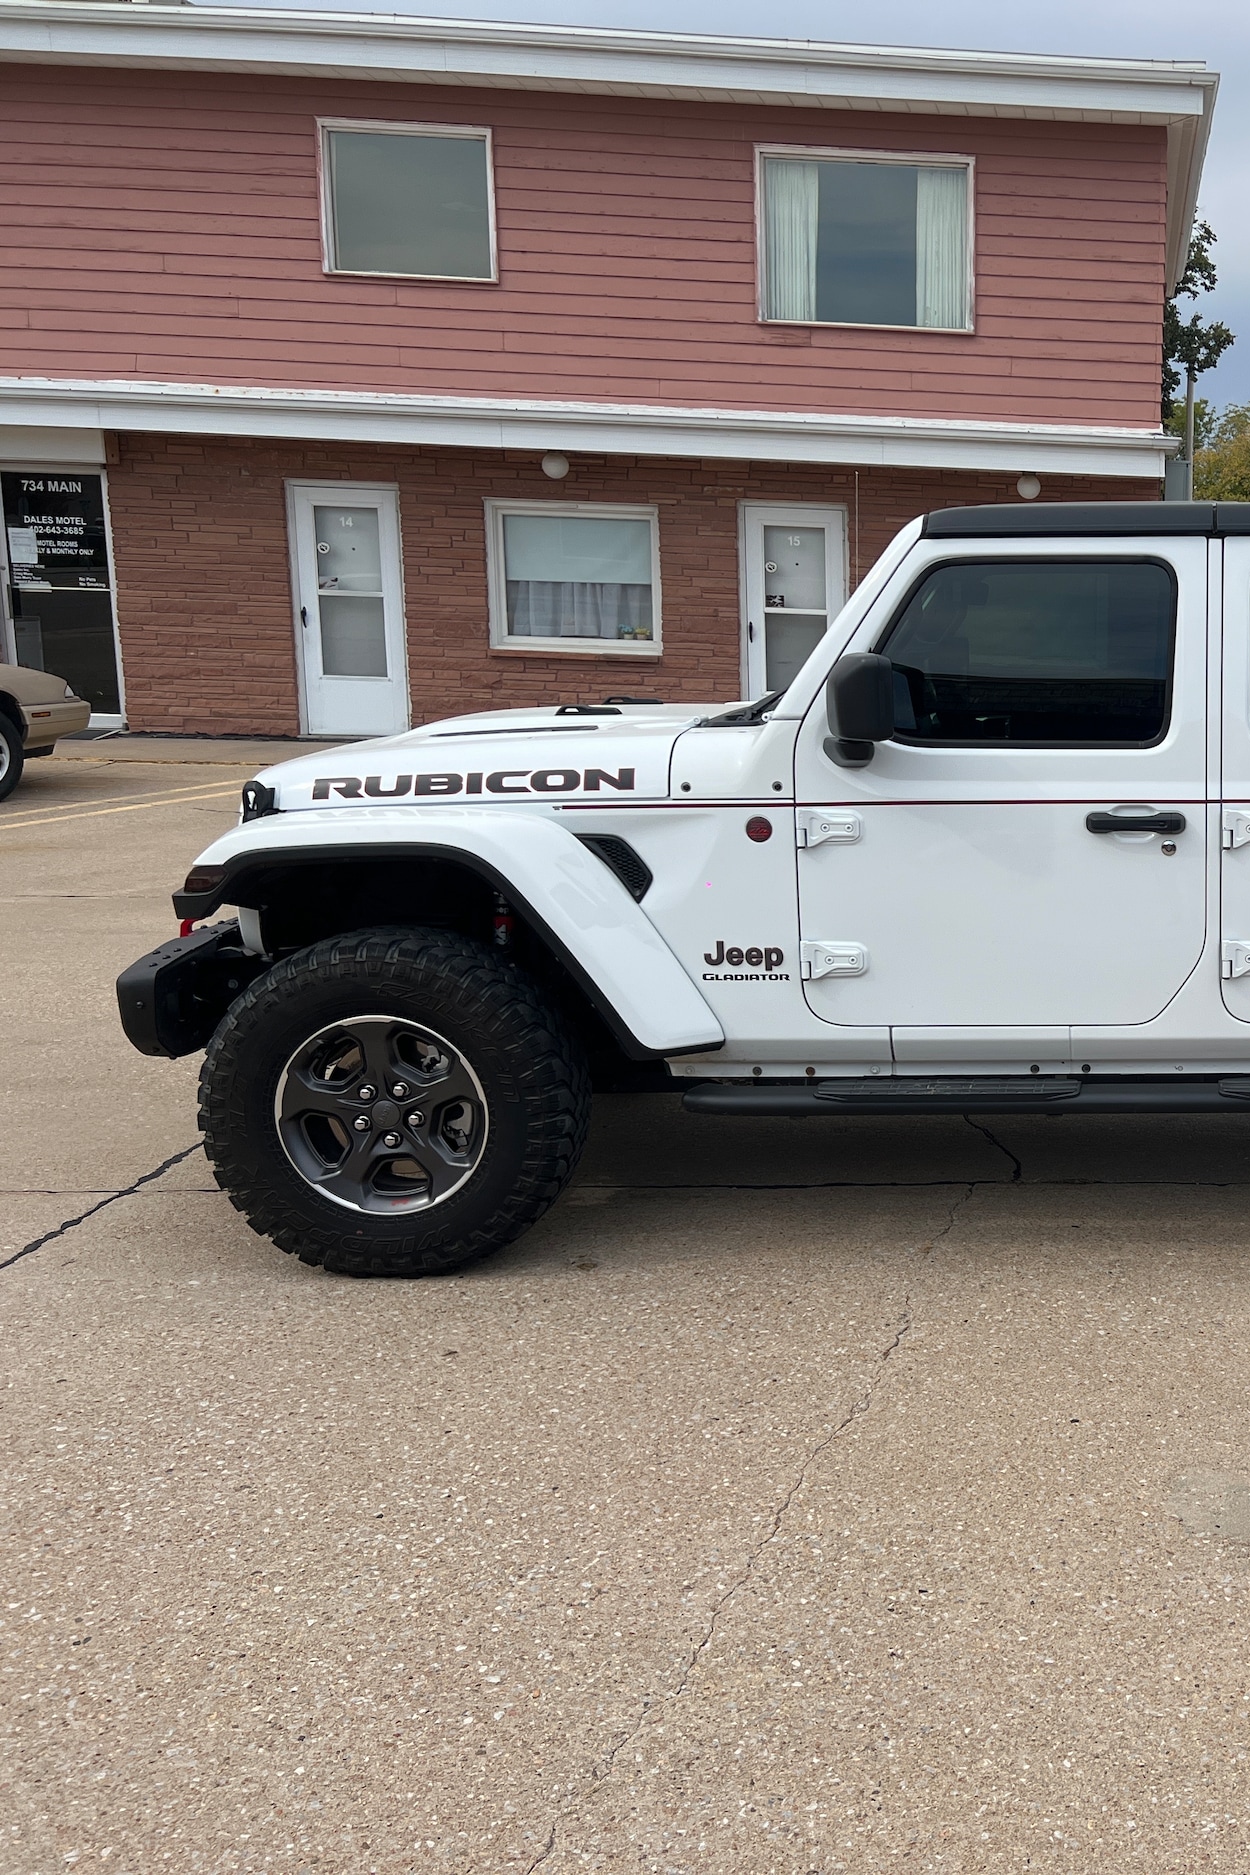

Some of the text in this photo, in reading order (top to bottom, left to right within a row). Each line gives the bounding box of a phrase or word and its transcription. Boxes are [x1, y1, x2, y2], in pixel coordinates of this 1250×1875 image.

[21, 480, 82, 493] 734 MAIN
[23, 515, 87, 525] DALES MOTEL
[339, 516, 354, 528] 14
[28, 525, 84, 535] 402-643-3685
[788, 536, 801, 546] 15
[312, 768, 635, 800] RUBICON
[704, 940, 784, 971] Jeep
[702, 973, 790, 981] GLADIATOR
